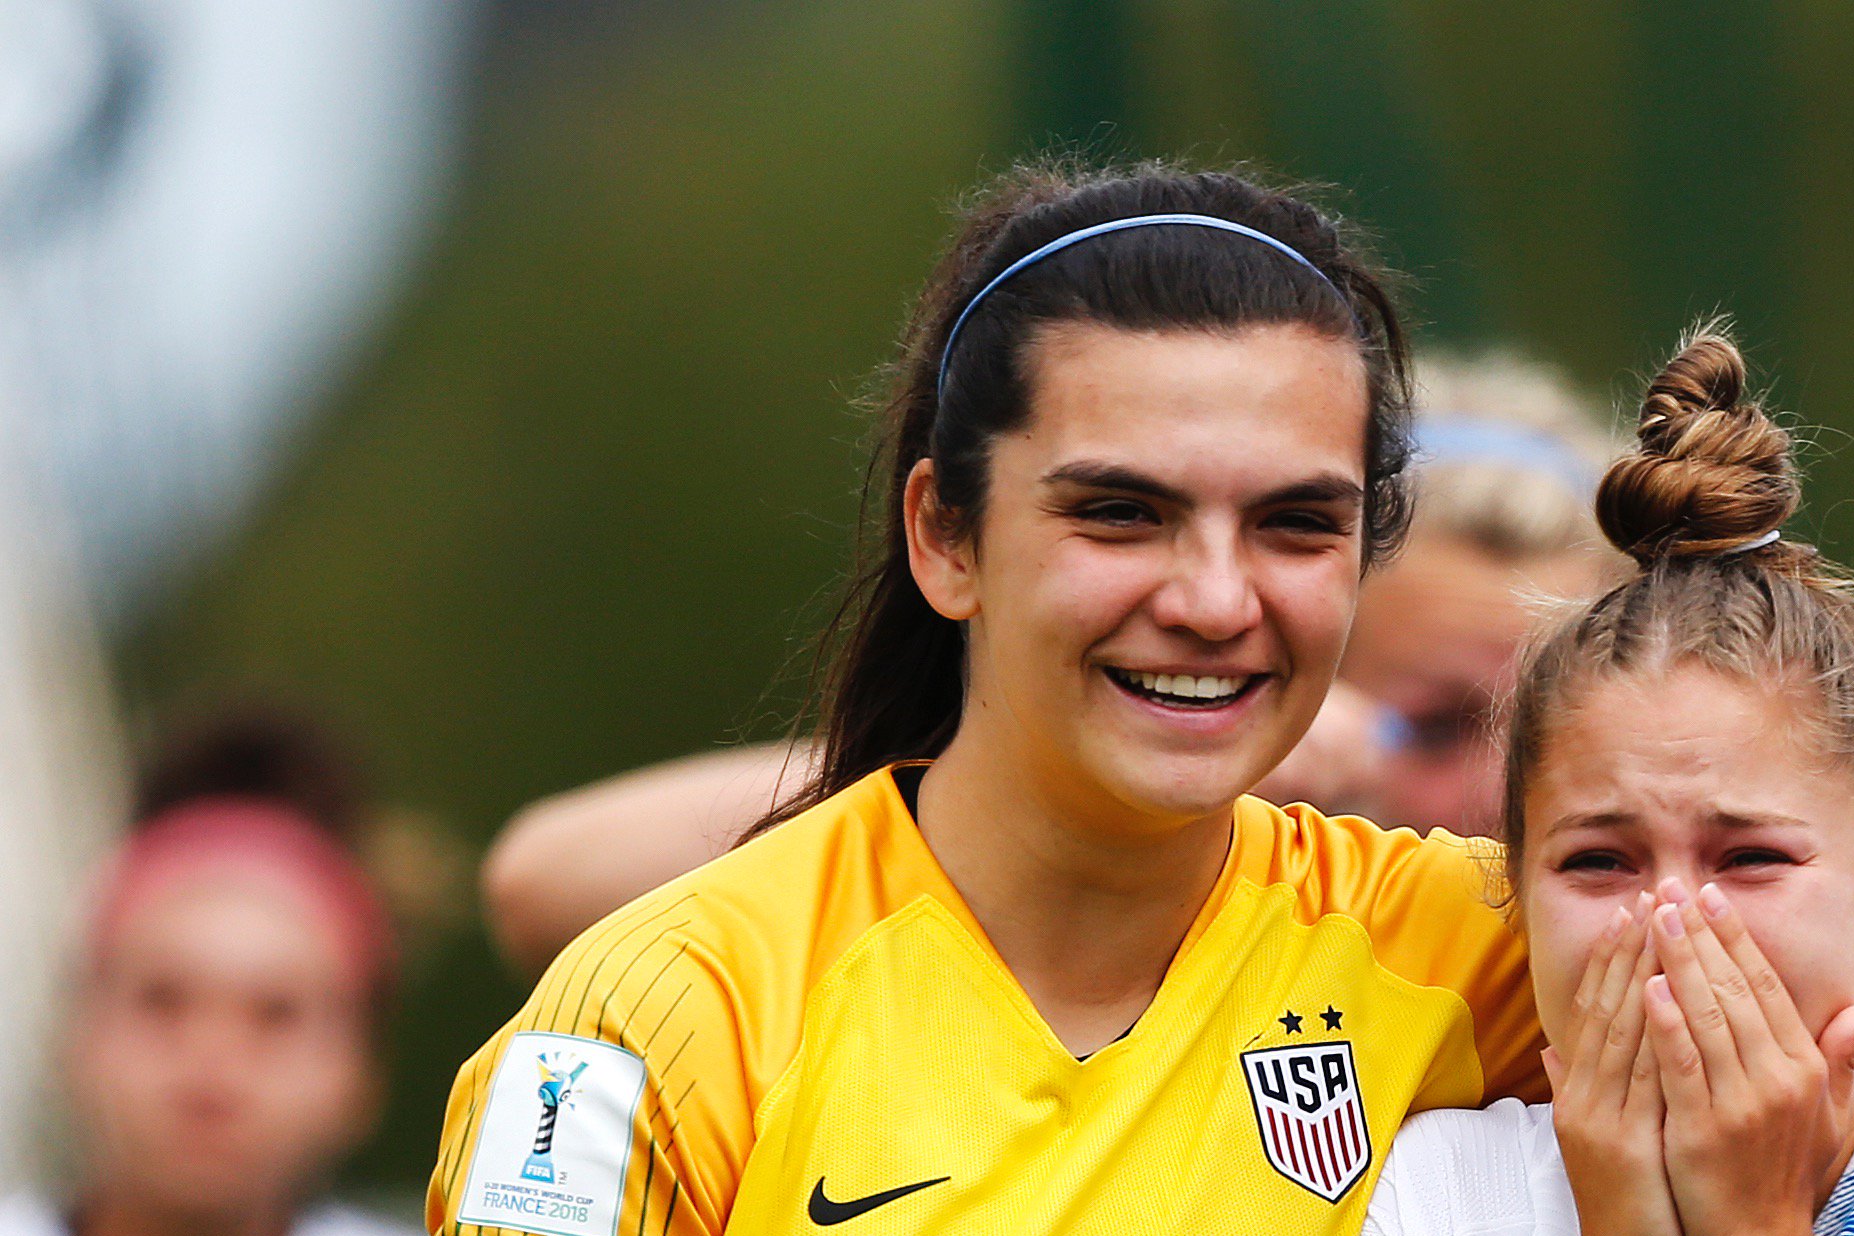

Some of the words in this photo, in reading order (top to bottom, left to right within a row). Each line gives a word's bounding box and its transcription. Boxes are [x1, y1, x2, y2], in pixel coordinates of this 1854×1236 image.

[1254, 1053, 1348, 1114] USA
[526, 1164, 550, 1178] FIFA
[483, 1191, 547, 1216] FRANCE
[549, 1202, 589, 1223] 2018
[541, 1190, 574, 1203] WORLD
[576, 1196, 594, 1205] CUP
